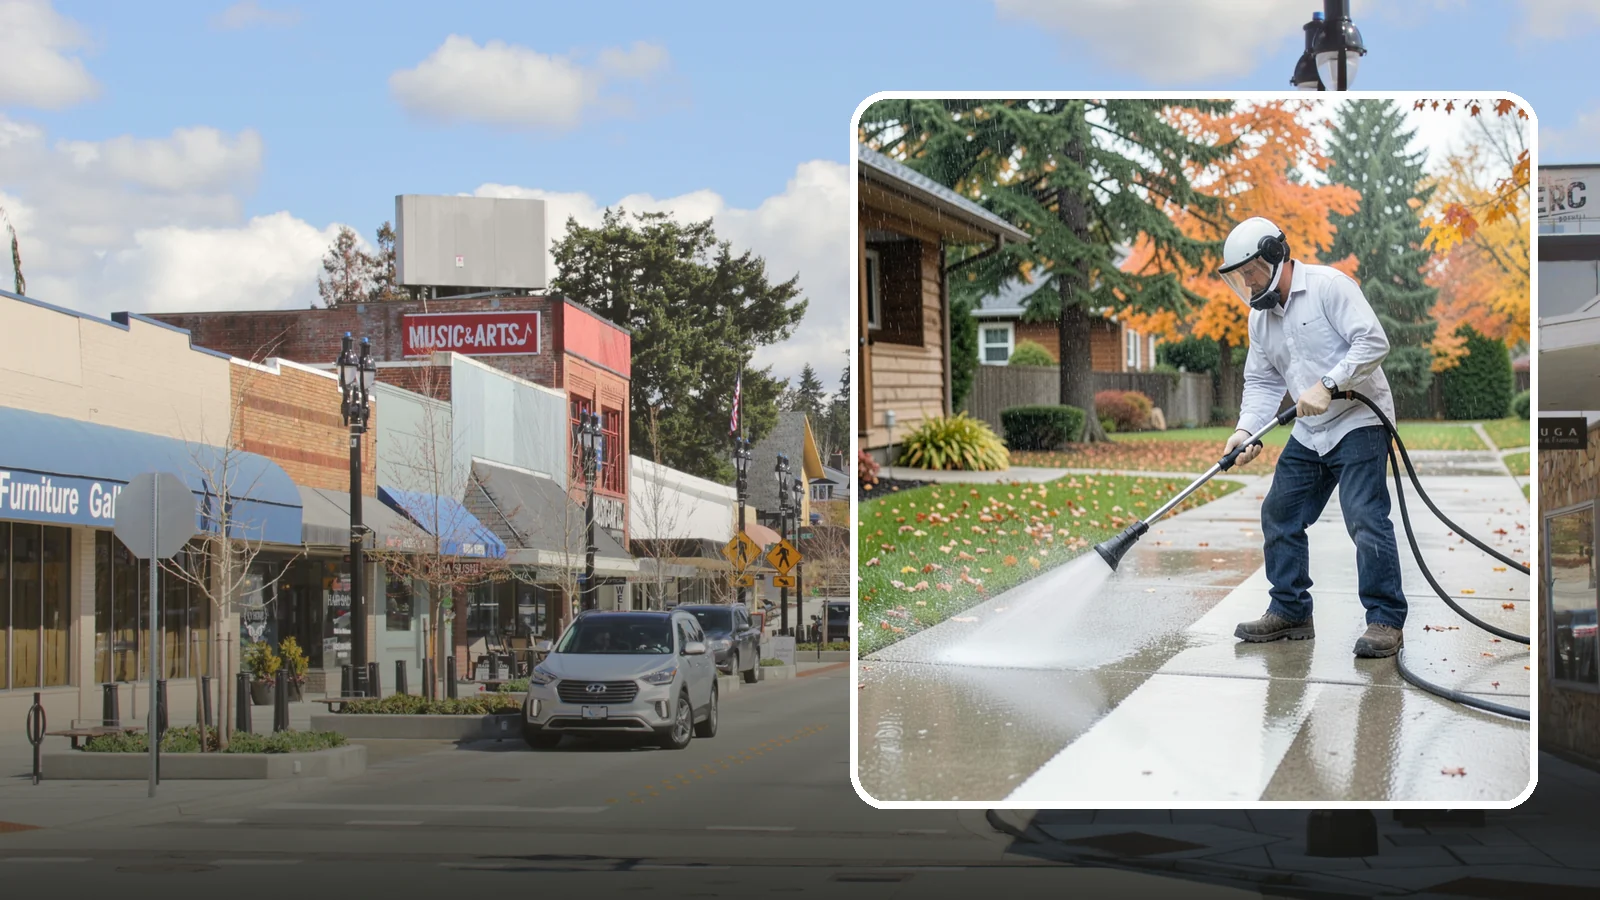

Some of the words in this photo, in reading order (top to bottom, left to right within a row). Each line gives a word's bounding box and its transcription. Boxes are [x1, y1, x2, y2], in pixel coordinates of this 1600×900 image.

[408, 323, 519, 349] MUSIC&ARTS
[0, 471, 79, 515] Furniture
[89, 482, 122, 519] Gal
